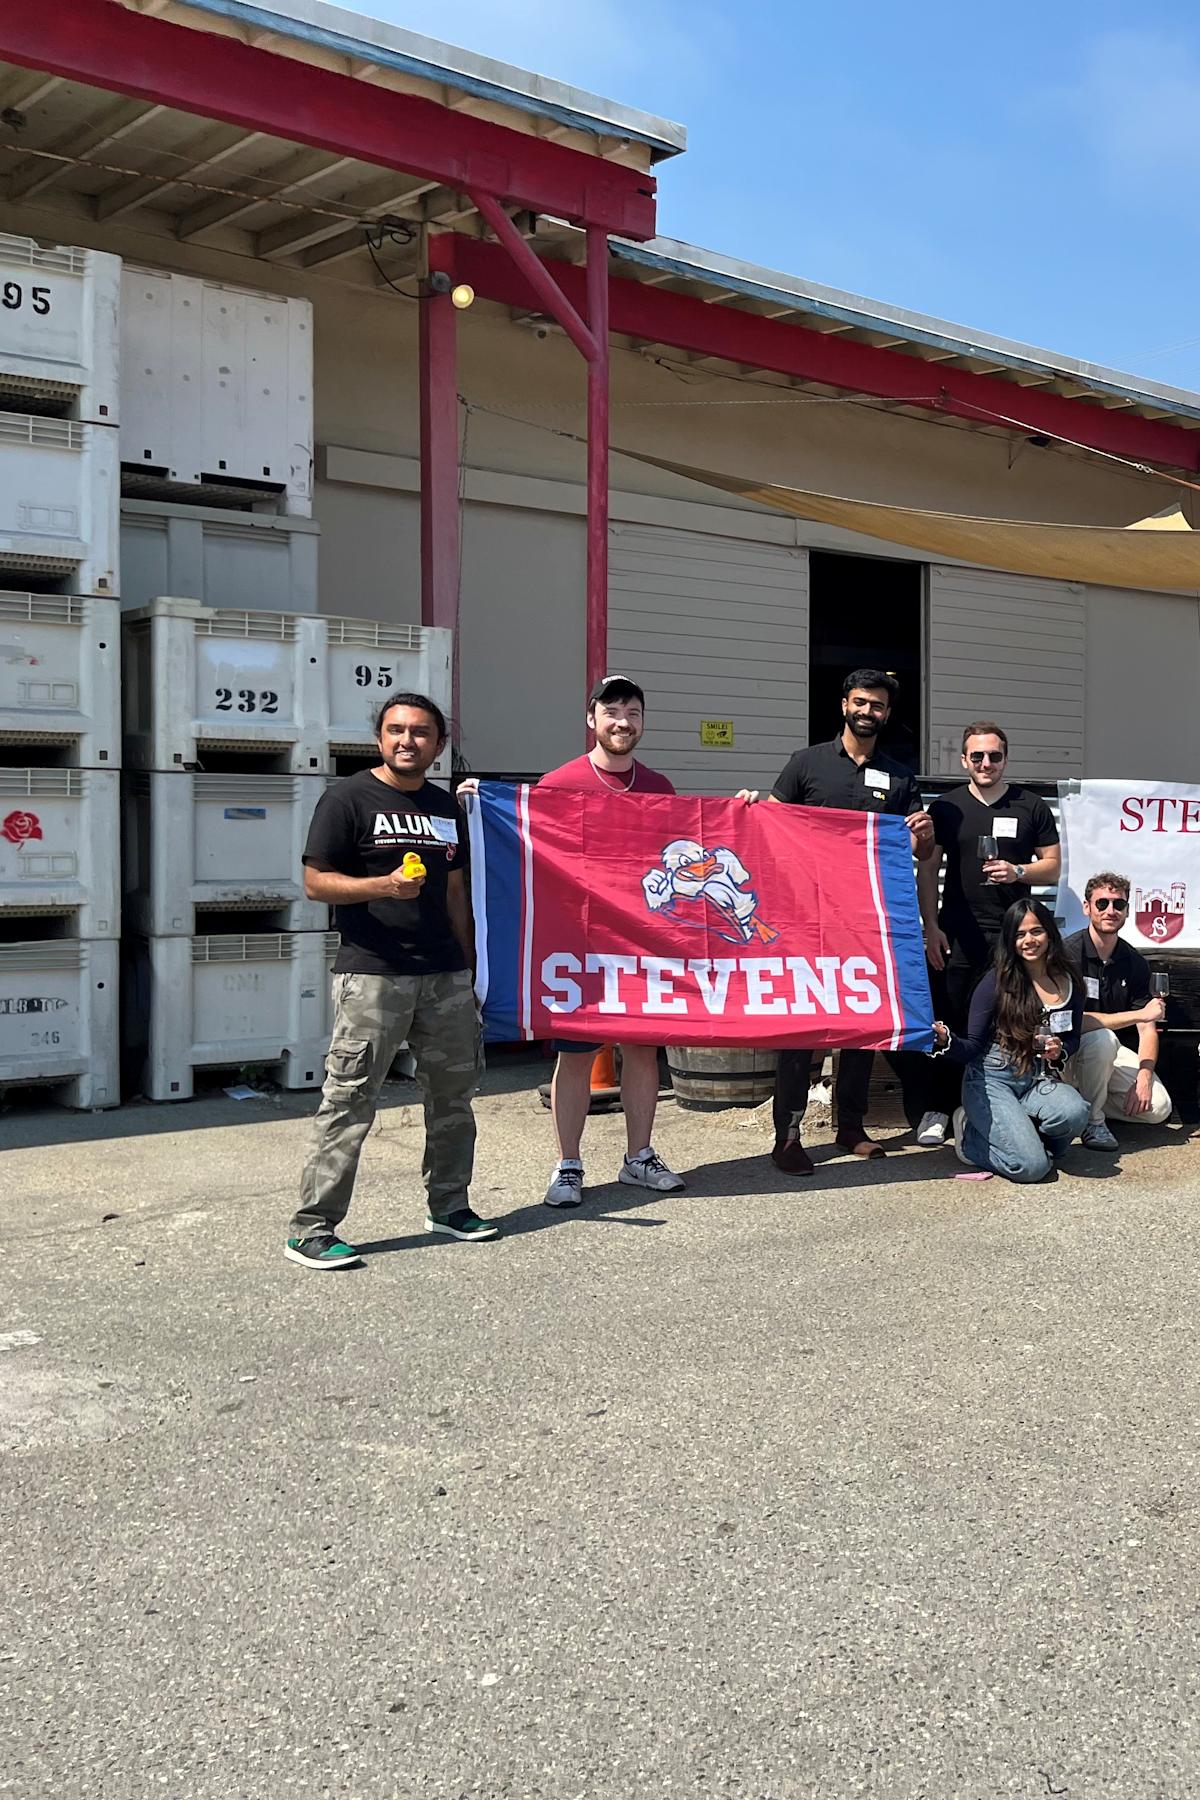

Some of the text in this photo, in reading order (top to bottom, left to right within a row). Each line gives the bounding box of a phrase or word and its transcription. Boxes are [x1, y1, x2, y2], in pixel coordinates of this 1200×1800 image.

[355, 665, 393, 688] 95
[215, 688, 278, 714] 232
[541, 952, 882, 1015] STEVENS
